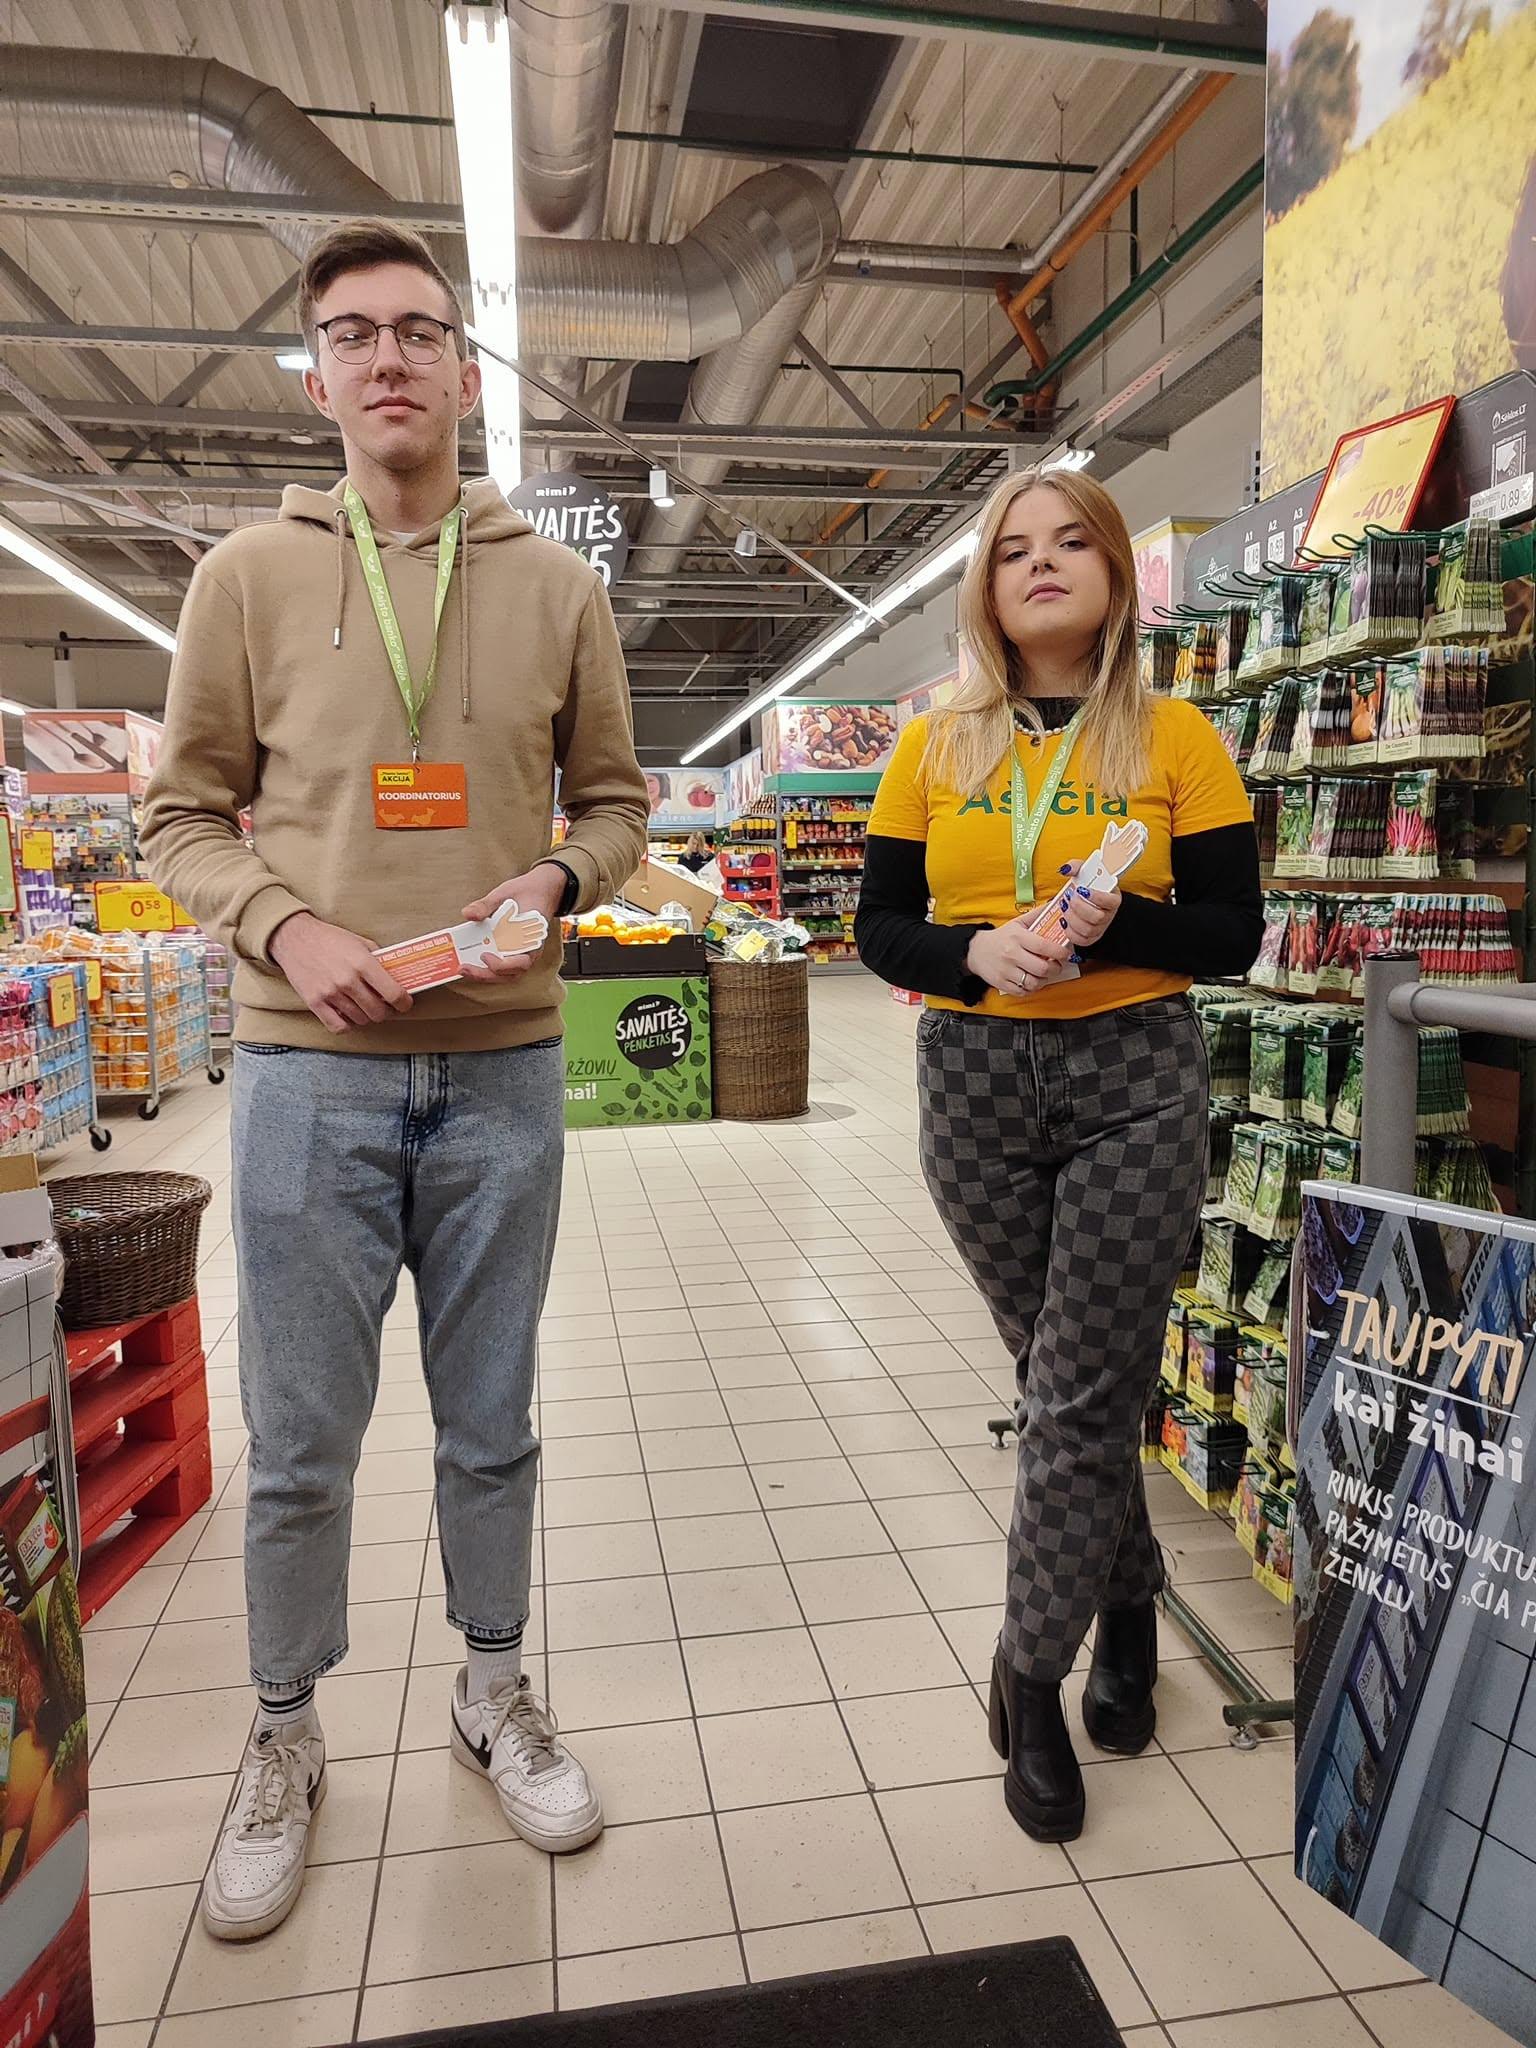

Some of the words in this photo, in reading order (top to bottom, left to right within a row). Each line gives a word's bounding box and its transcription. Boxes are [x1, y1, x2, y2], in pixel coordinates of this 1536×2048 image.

[517, 497, 622, 542] VAITĖS
[1293, 507, 1304, 521] A3
[1353, 482, 1413, 522] -40%
[1244, 530, 1253, 543] A1
[1267, 519, 1278, 532] A2
[590, 543, 613, 588] 5
[378, 792, 461, 801] KOORDINATORIUS
[616, 1005, 688, 1041] SAVAITĖS
[624, 1032, 671, 1054] PENKETAS
[671, 1028, 686, 1057] 5
[1336, 1290, 1524, 1406] TAUPYTI
[1333, 1370, 1397, 1434] kai
[1407, 1399, 1523, 1484] žinai
[1326, 1470, 1396, 1521] RINKIS
[1402, 1502, 1536, 1583] PRODUKTU
[1324, 1509, 1454, 1590] PAŽYMĖTUS
